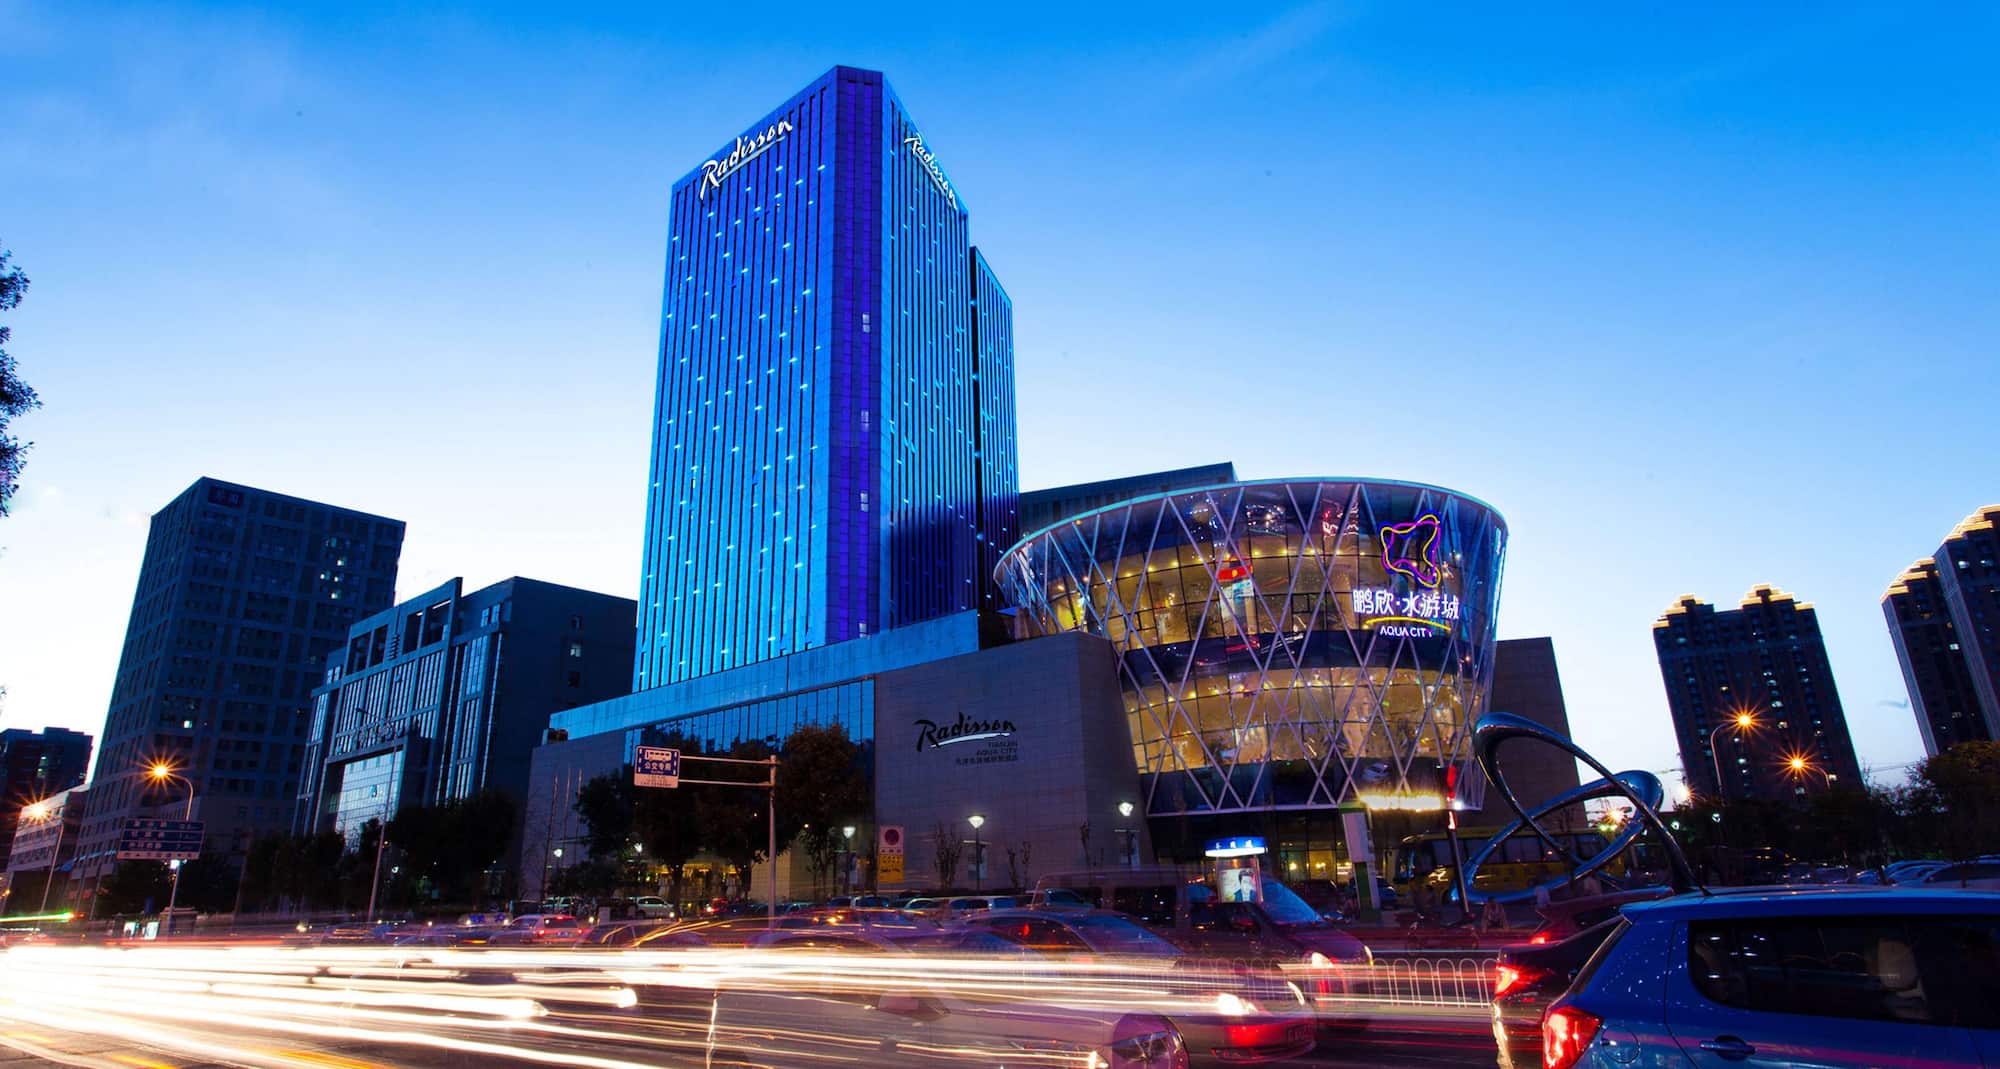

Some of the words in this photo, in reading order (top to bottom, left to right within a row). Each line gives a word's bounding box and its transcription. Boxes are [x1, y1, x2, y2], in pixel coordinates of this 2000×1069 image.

[700, 118, 793, 200] Radisson
[903, 132, 959, 210] Radisson
[1380, 625, 1410, 637] AQUA
[1410, 626, 1433, 638] CITY
[913, 712, 1017, 752] Radisson
